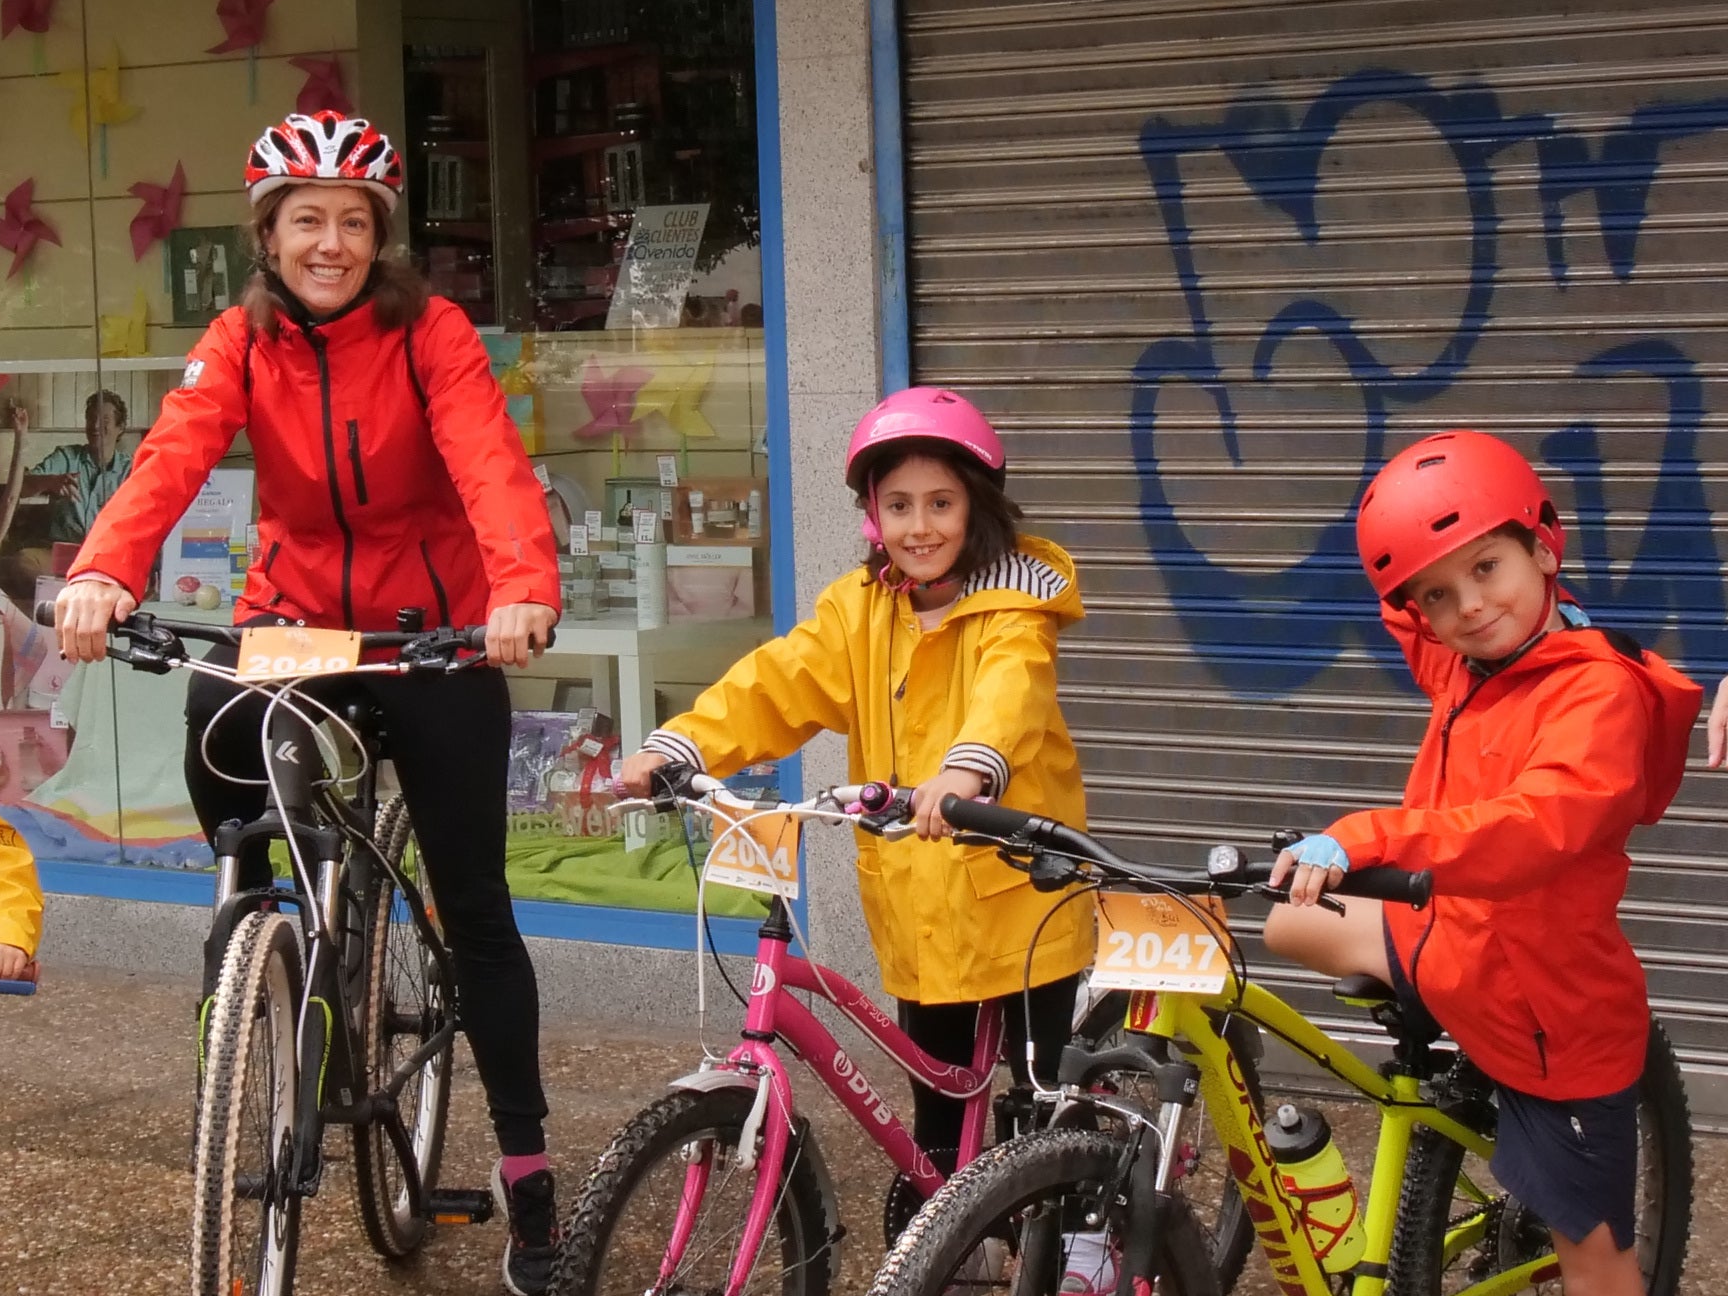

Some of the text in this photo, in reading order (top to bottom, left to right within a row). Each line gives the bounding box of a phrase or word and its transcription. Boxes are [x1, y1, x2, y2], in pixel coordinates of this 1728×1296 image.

[663, 210, 699, 228] CLUB
[651, 228, 701, 244] CLIENTES
[1105, 931, 1219, 971] 2047
